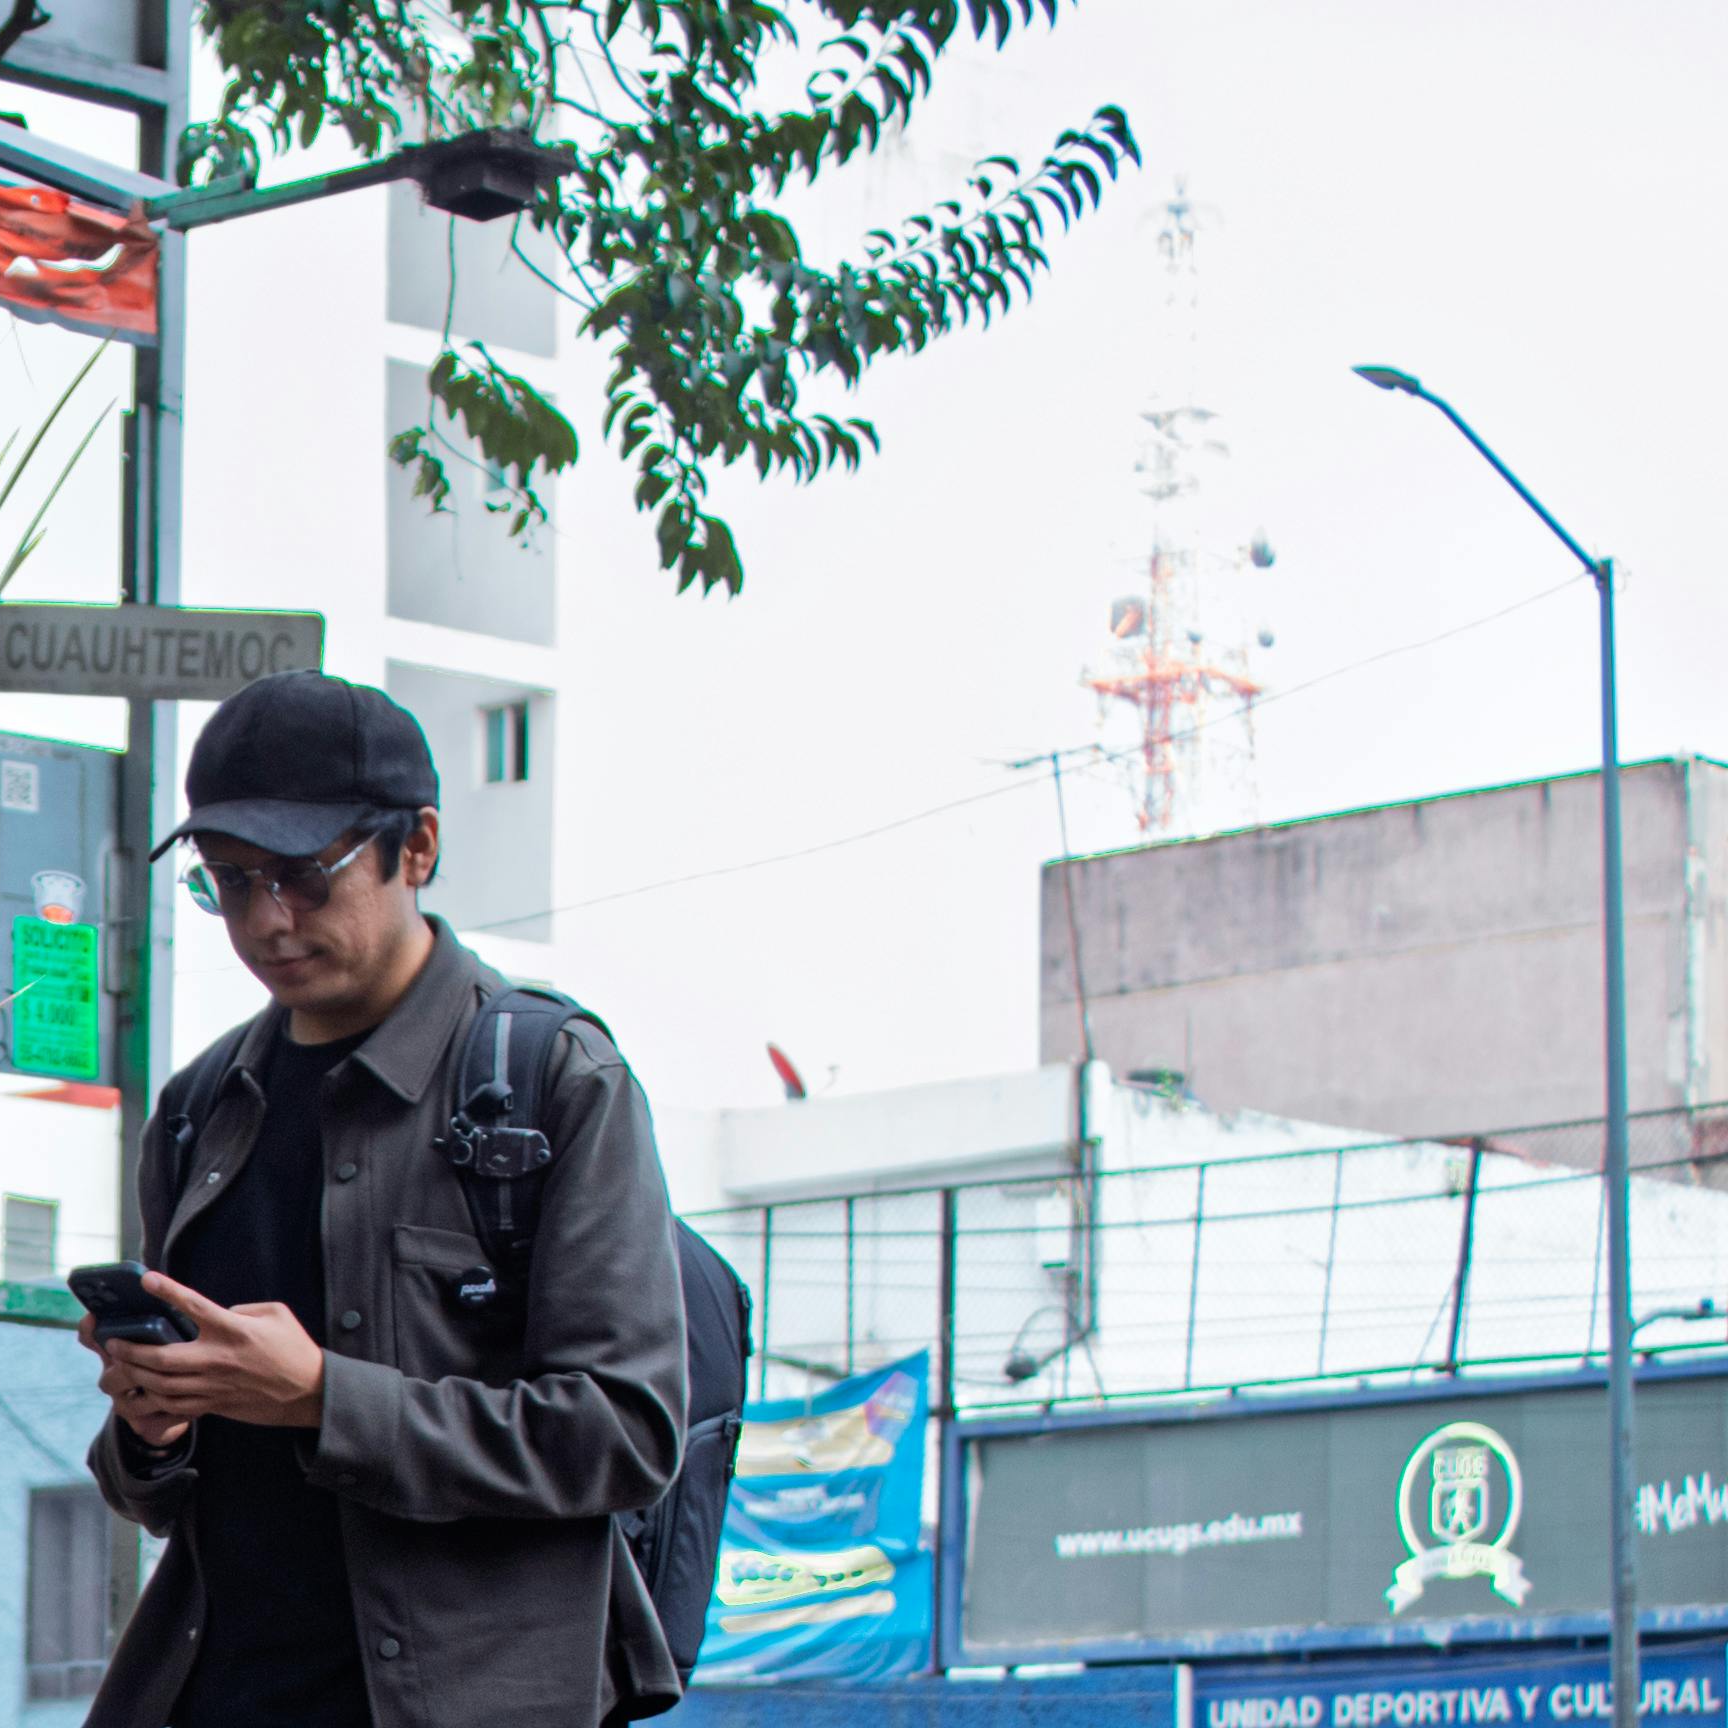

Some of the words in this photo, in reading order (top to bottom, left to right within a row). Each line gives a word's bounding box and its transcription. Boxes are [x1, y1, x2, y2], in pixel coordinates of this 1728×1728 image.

[4, 622, 295, 681] CUAUHTEMOC
[1519, 1685, 1540, 1719] Y
[1549, 1679, 1722, 1721] CULURAL
